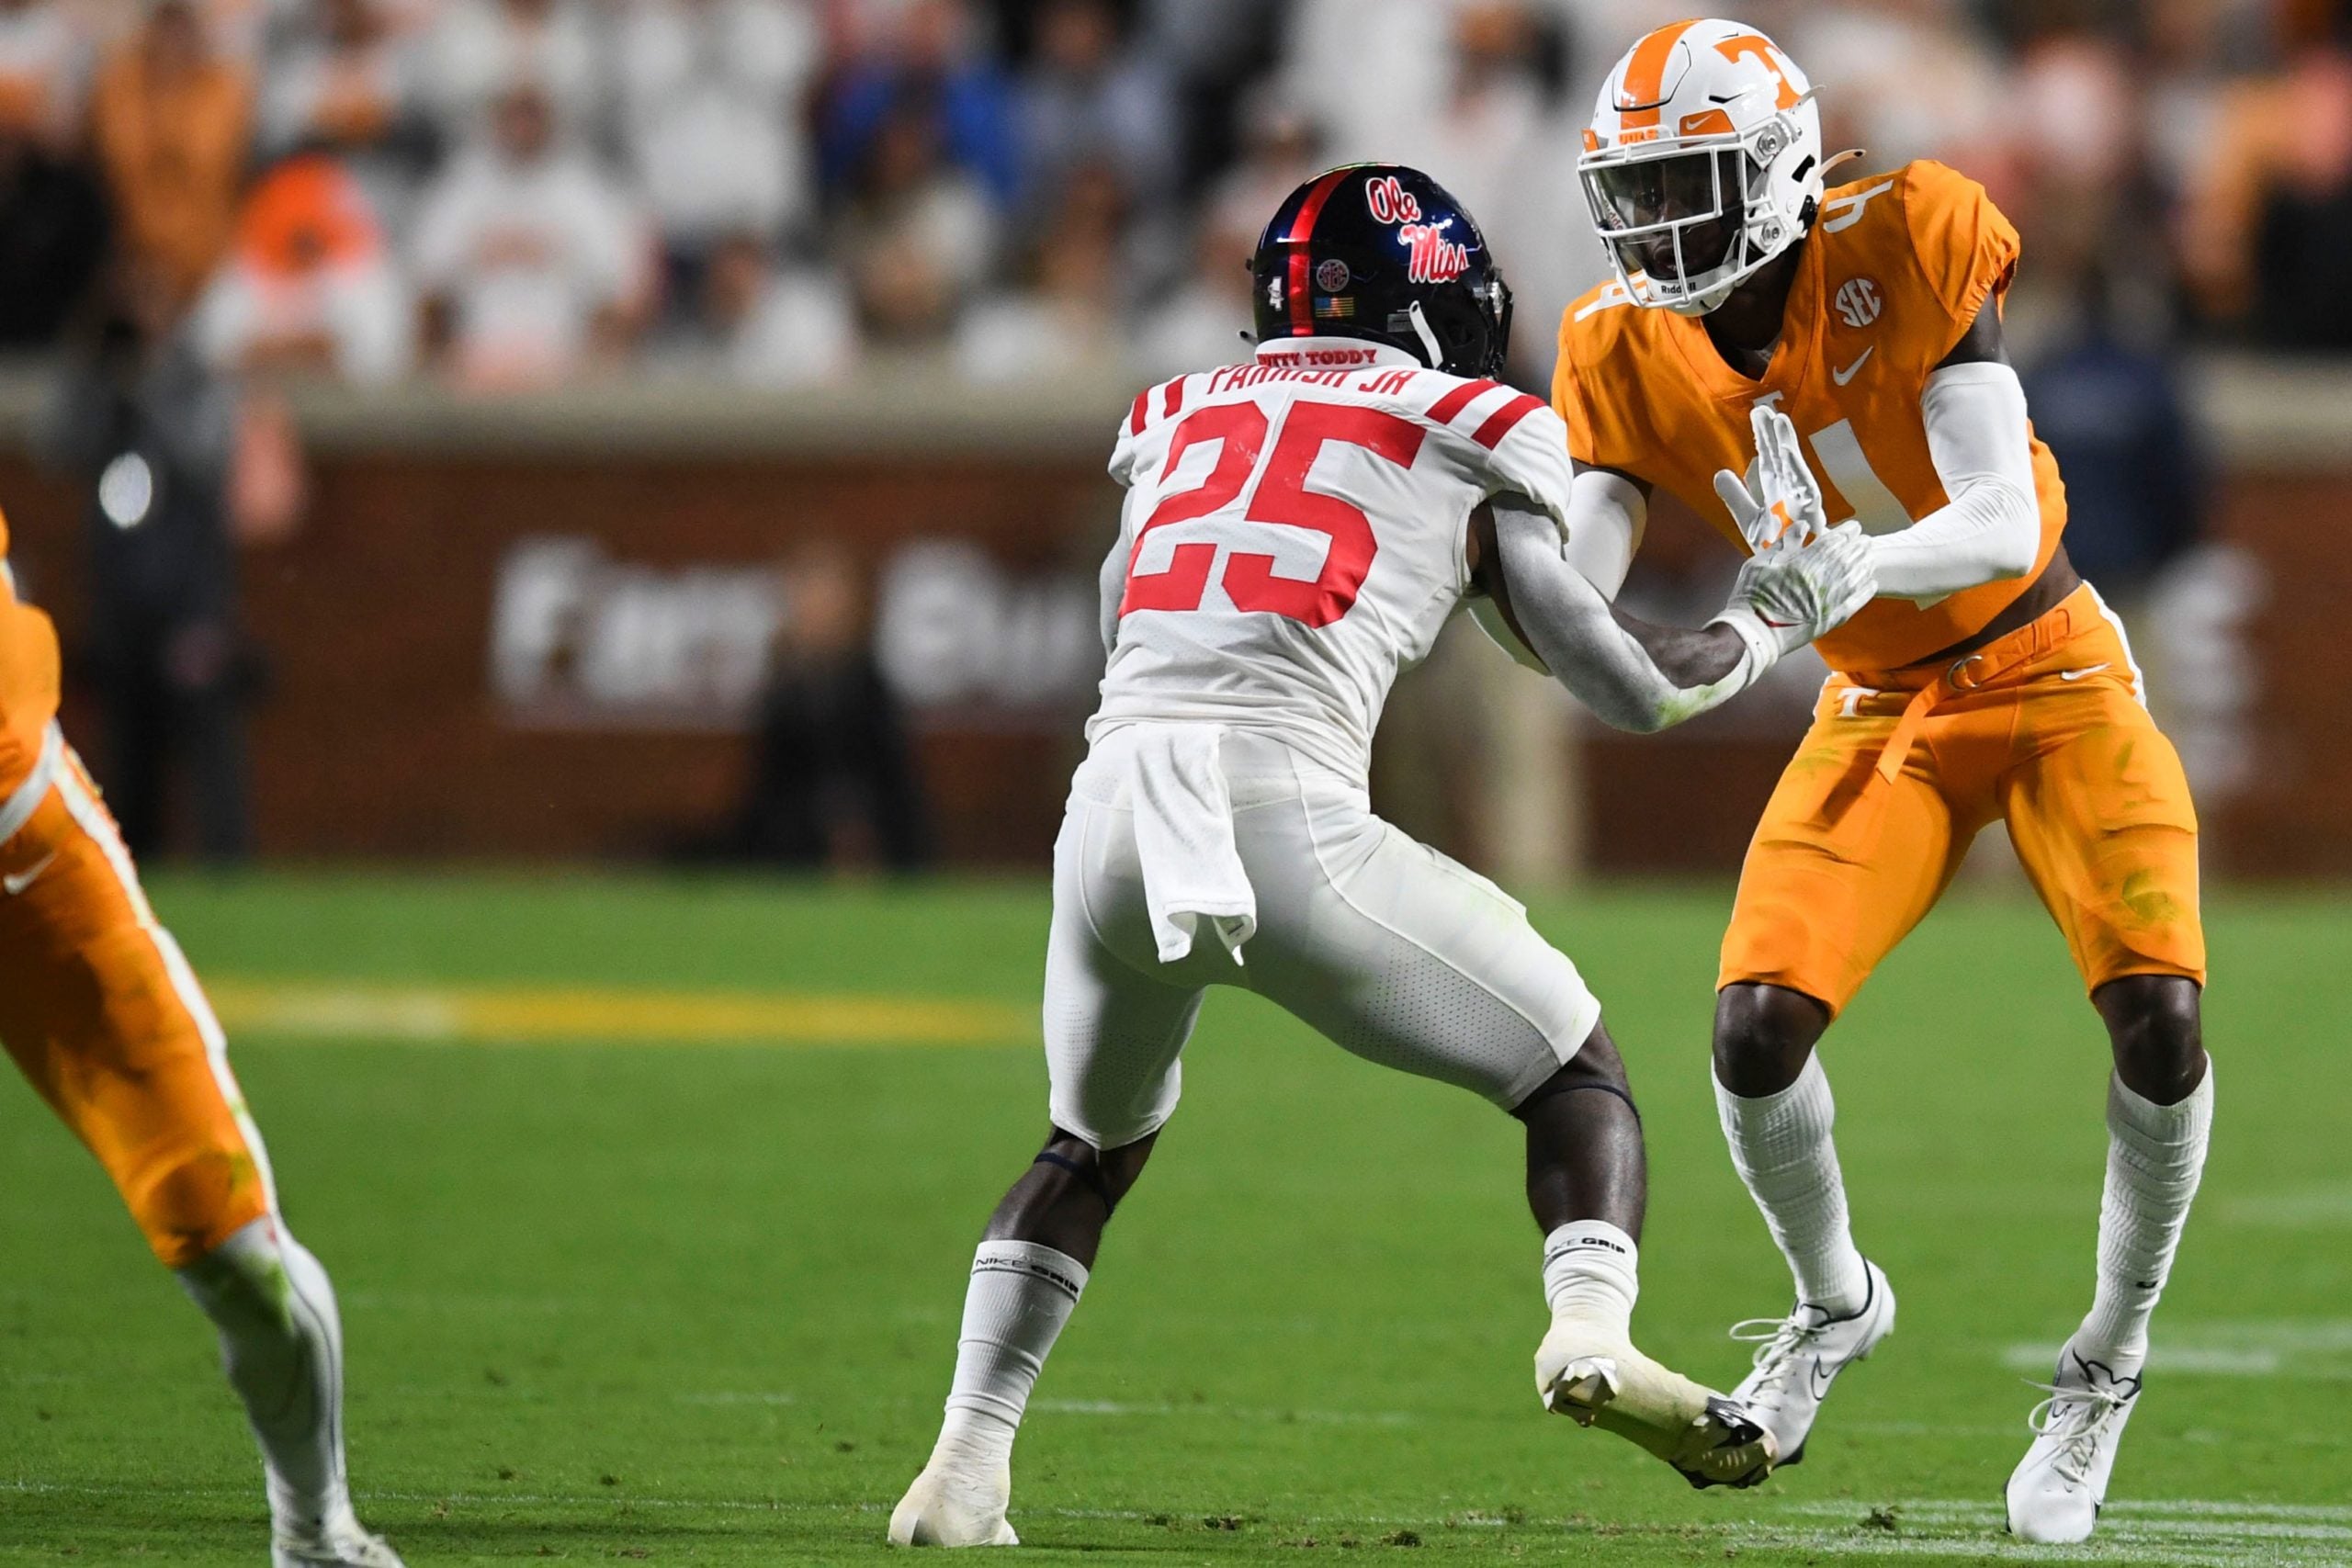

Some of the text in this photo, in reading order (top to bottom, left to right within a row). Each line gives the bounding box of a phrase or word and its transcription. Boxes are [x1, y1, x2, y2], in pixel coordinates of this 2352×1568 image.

[1365, 175, 1421, 224] Ole
[1397, 223, 1470, 284] Miss
[1661, 281, 1696, 294] Riddll
[1836, 278, 1881, 328] SEC
[1306, 349, 1377, 366] TODDY
[1358, 370, 1420, 396] JR
[1118, 400, 1428, 629] 25
[1581, 1237, 1625, 1254] GRIP
[976, 1258, 1025, 1268] NIKE
